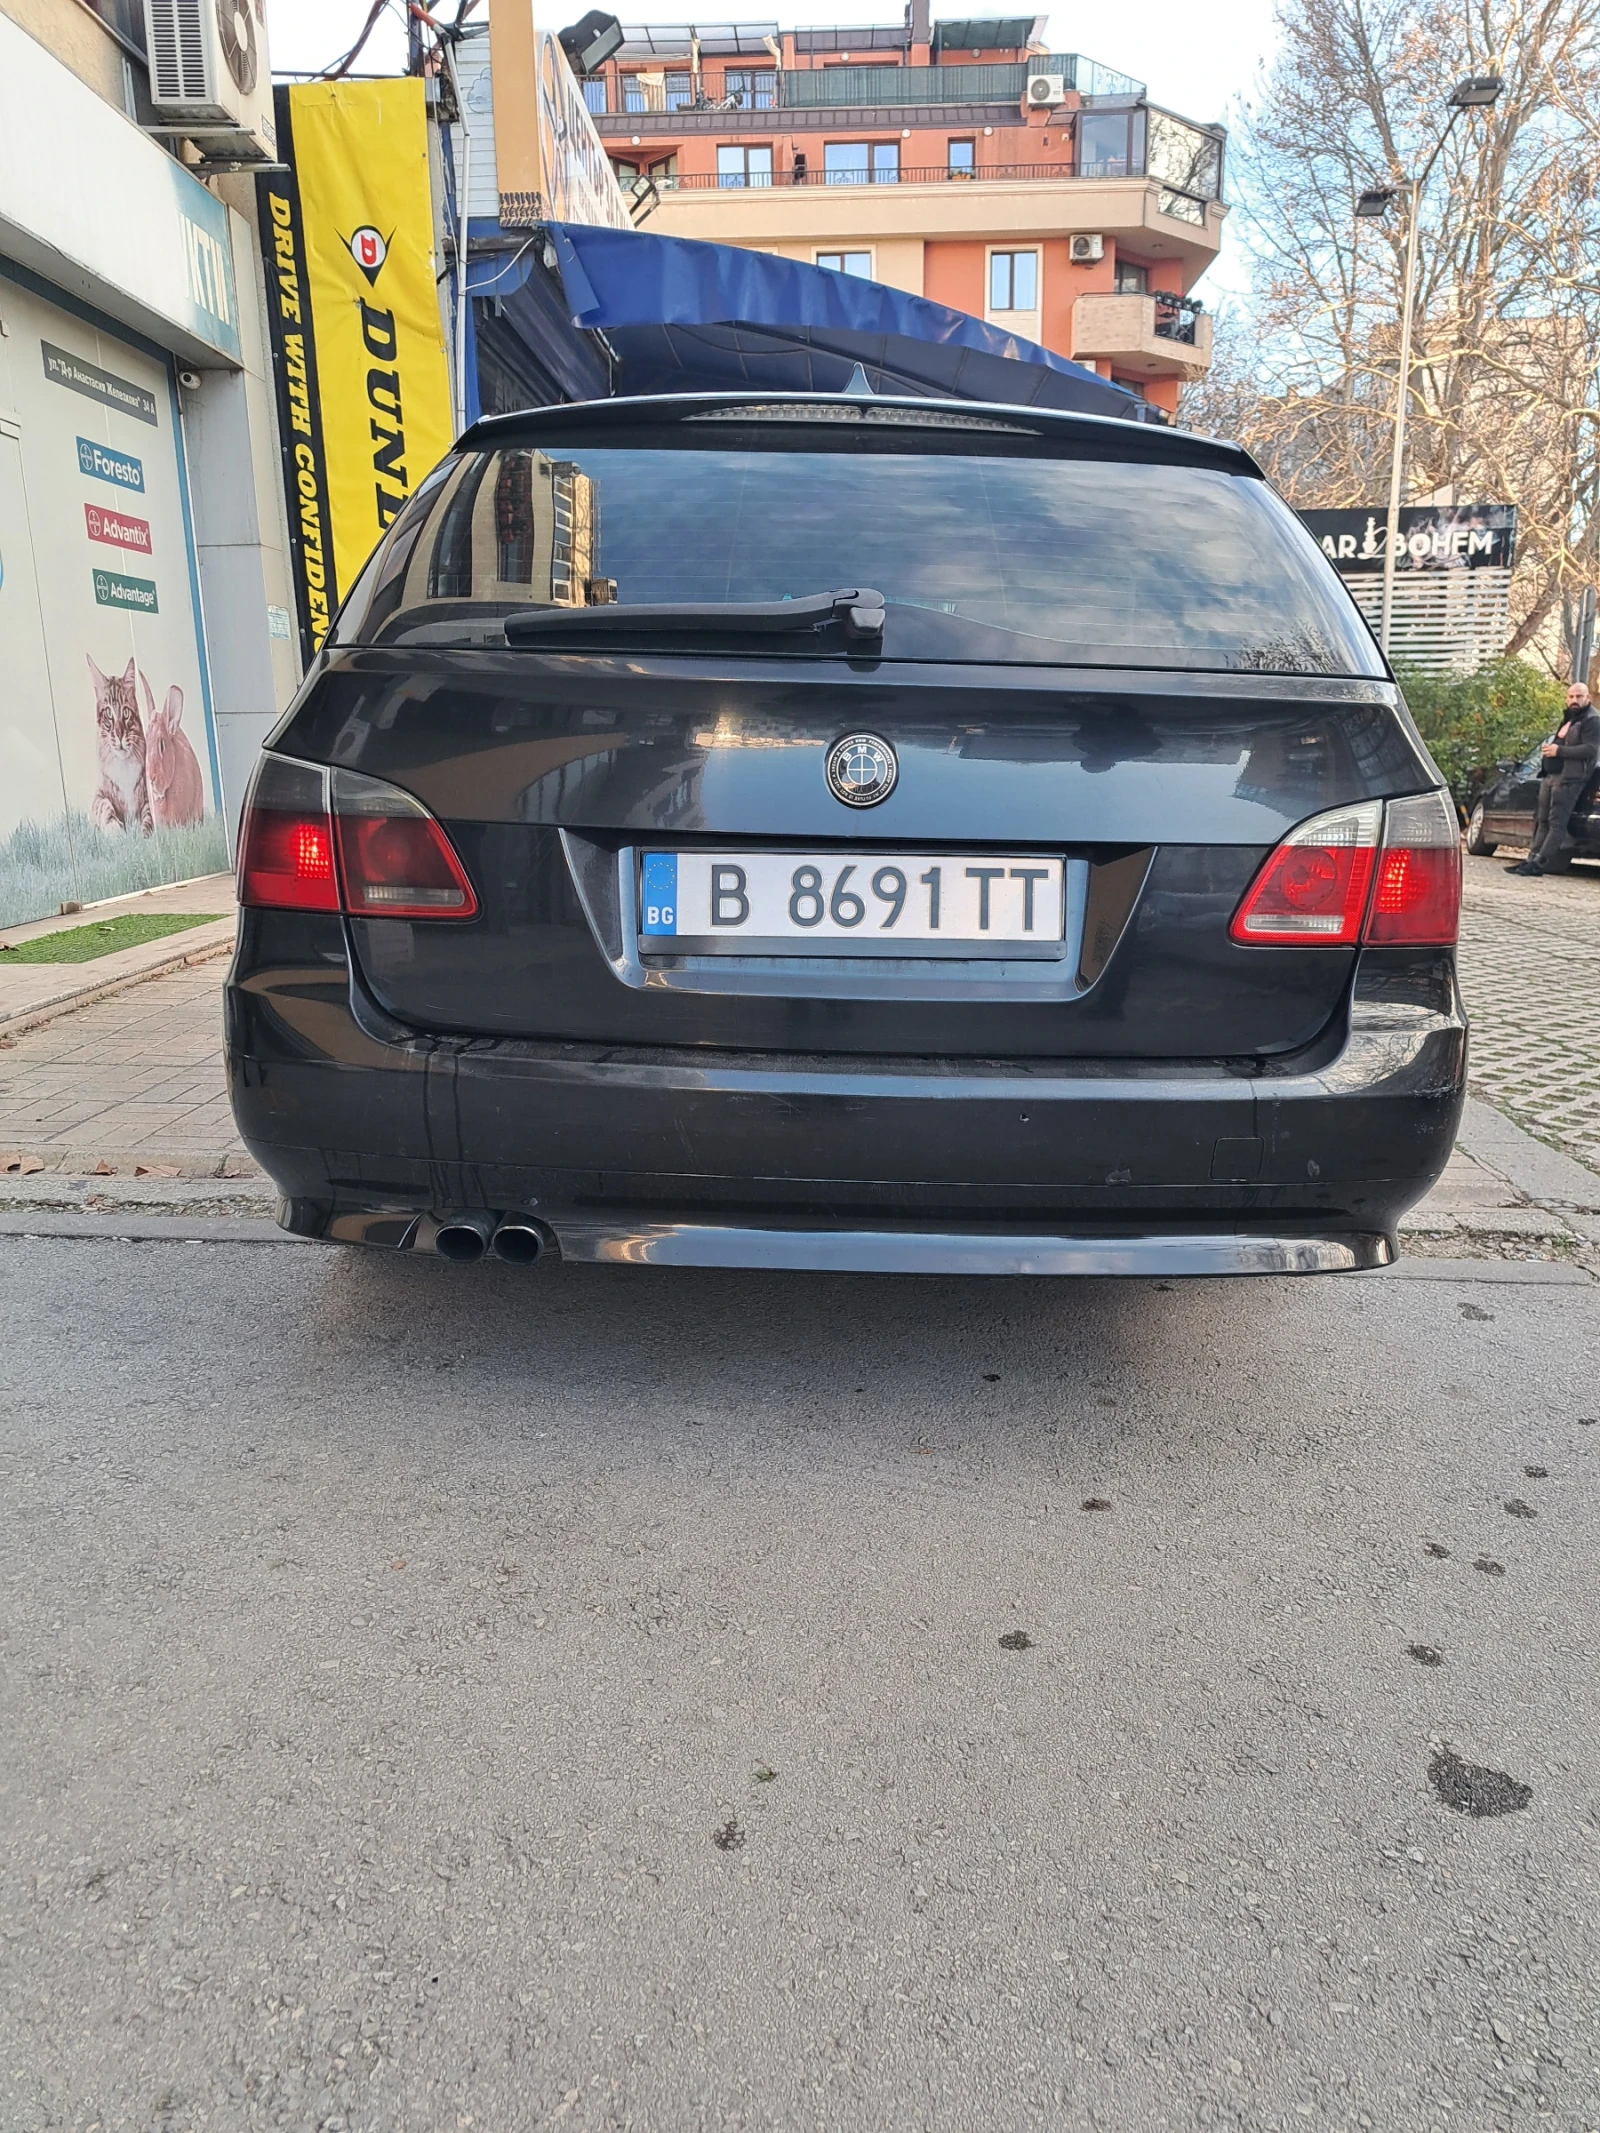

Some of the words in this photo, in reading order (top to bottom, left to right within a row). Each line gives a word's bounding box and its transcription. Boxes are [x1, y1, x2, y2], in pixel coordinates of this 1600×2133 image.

[269, 191, 302, 325] DRIVE
[284, 333, 312, 437] WITH
[93, 449, 141, 486] Foresto
[103, 516, 149, 547] Advantix
[110, 581, 155, 607] Advantage
[842, 746, 884, 763] BMW
[710, 864, 750, 928] B
[788, 864, 942, 930] 8691
[965, 867, 1050, 932] TT
[647, 906, 674, 925] BG
